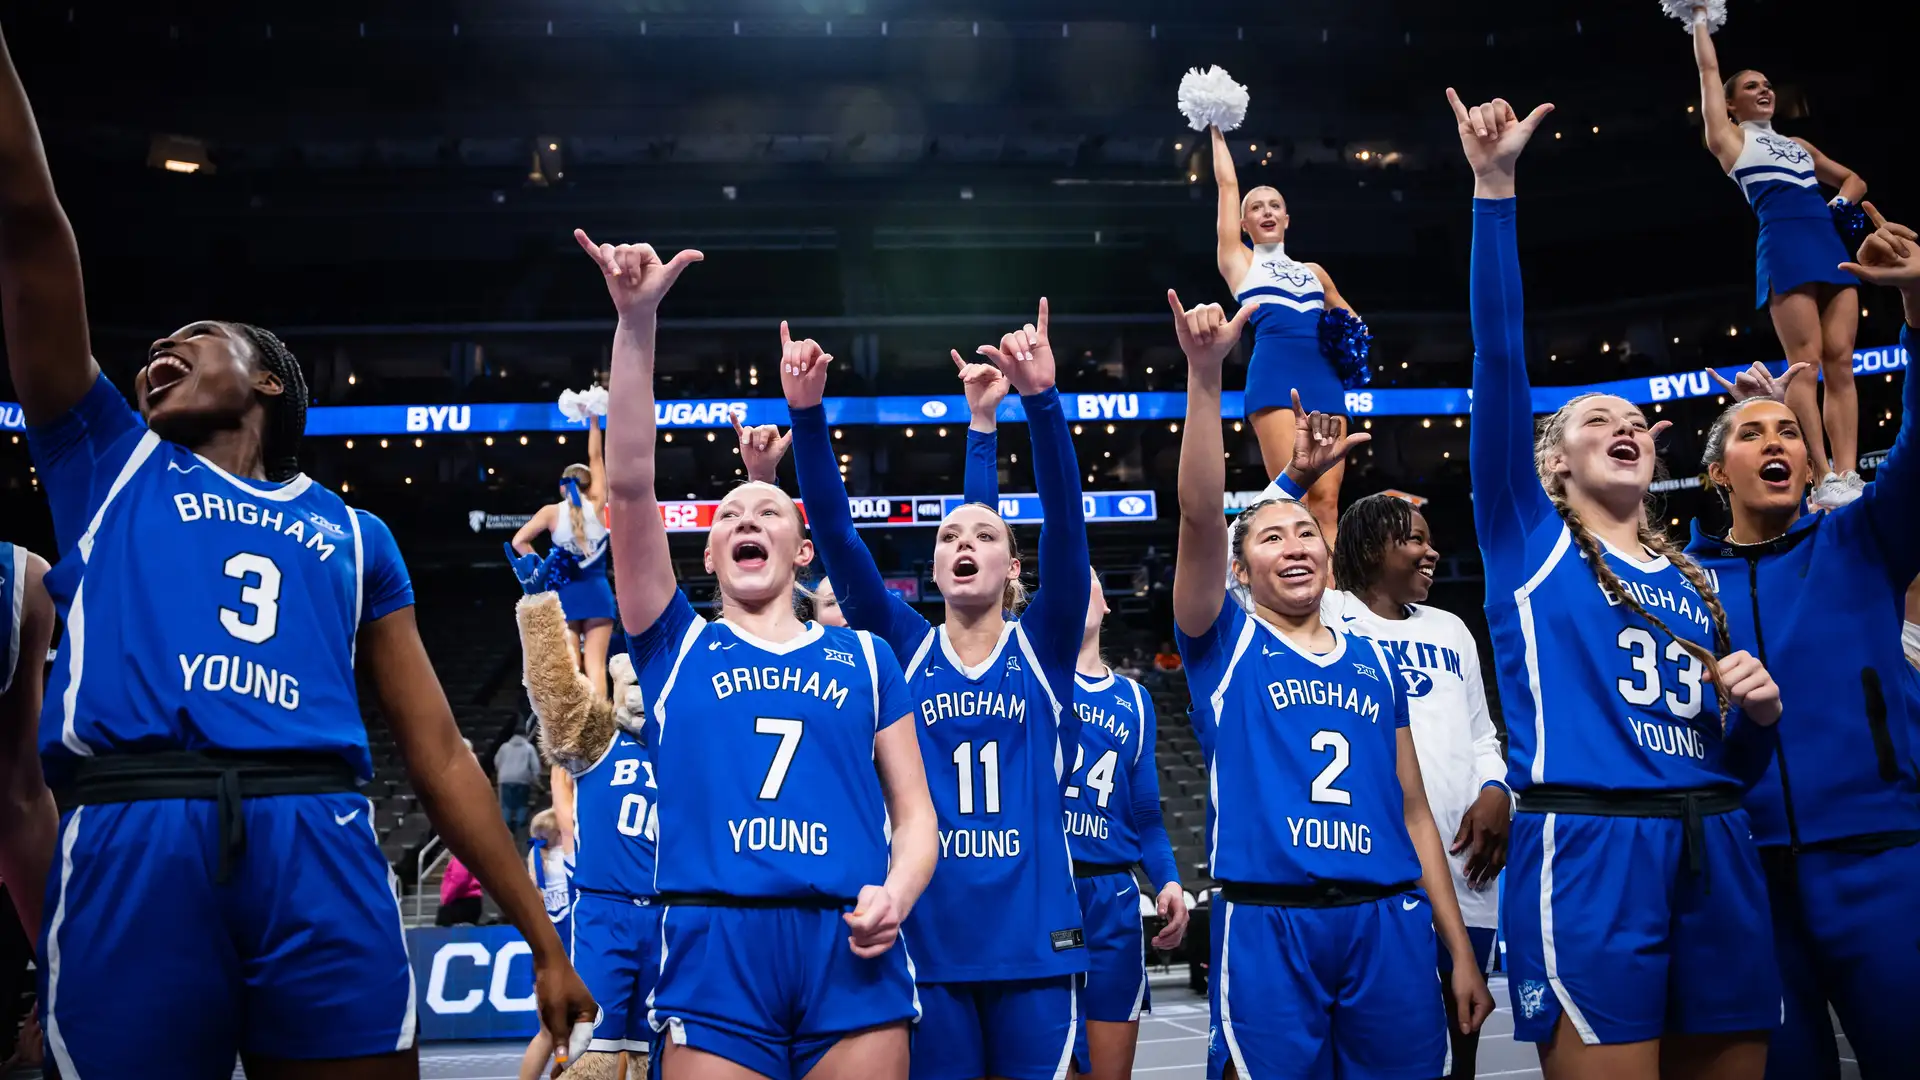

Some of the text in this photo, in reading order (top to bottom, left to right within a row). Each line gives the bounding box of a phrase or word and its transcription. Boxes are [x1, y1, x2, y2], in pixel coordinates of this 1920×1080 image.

[1077, 394, 1139, 419] BYU
[1650, 371, 1710, 401] BYU
[406, 405, 471, 431] BYU
[655, 402, 748, 425] UGARS
[173, 492, 336, 562] BRIGHAM
[664, 505, 698, 527] 52
[917, 503, 941, 516] 4TH
[219, 552, 282, 644] 3
[1598, 576, 1710, 634] BRIGHAM
[1415, 642, 1438, 669] IT
[1616, 626, 1704, 720] 33
[179, 653, 300, 711] YOUNG
[711, 666, 849, 710] BRIGHAM
[1267, 679, 1380, 724] BRIGHAM
[921, 690, 1026, 727] BRIGHAM
[755, 716, 803, 801] 7
[1628, 716, 1706, 760] YOUNG
[953, 740, 1000, 815] 11
[1310, 729, 1352, 806] 2
[728, 817, 828, 856] YOUNG
[939, 828, 1020, 859] YOUNG
[1287, 816, 1372, 855] YOUNG
[426, 940, 538, 1014] CO
